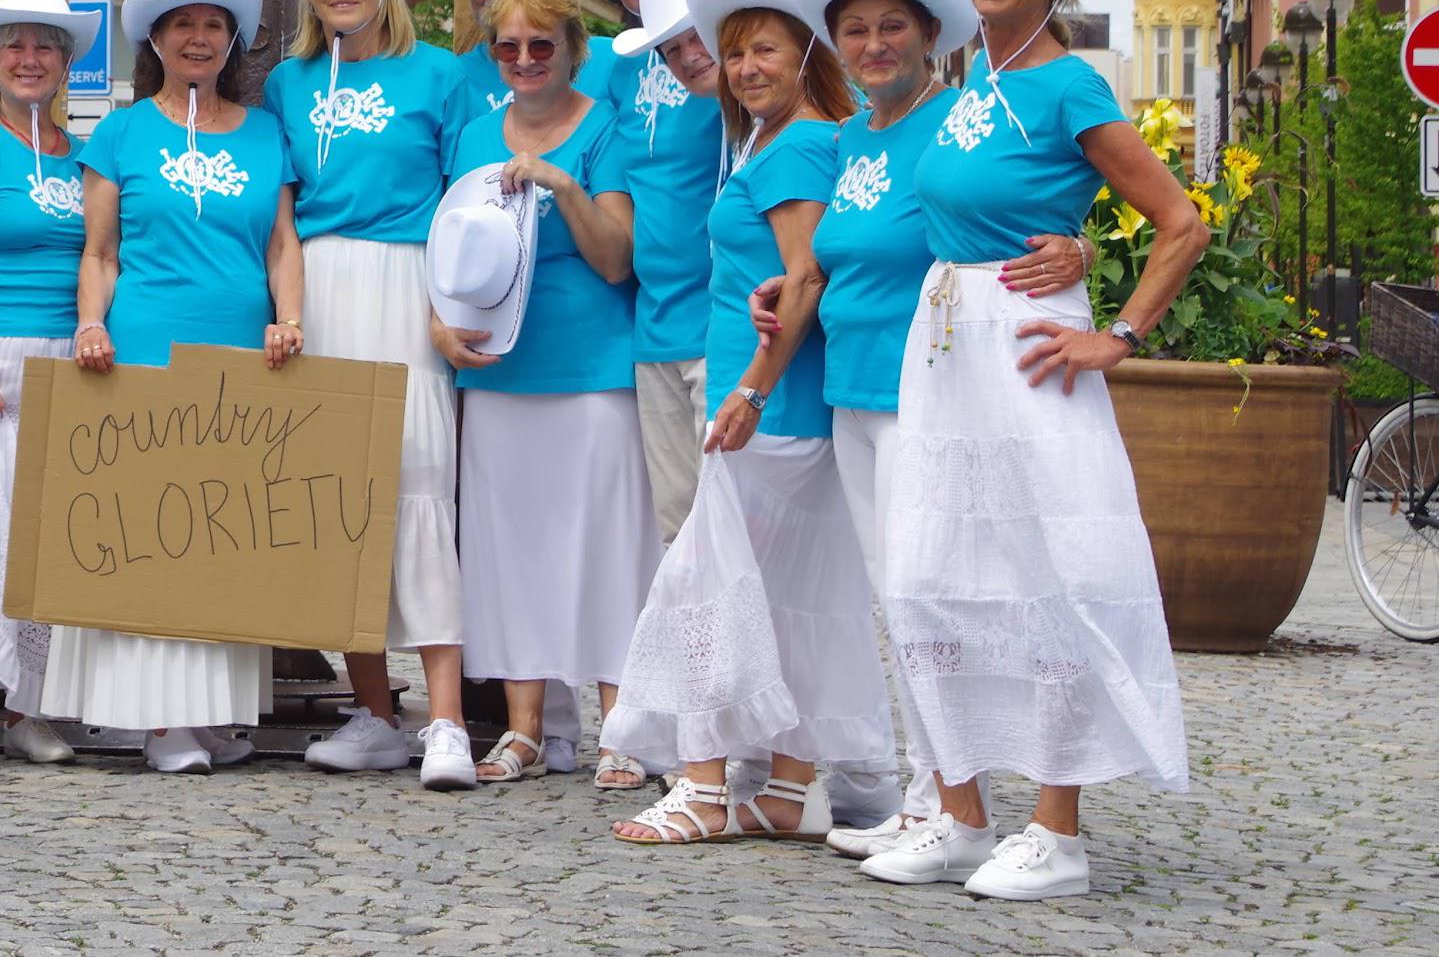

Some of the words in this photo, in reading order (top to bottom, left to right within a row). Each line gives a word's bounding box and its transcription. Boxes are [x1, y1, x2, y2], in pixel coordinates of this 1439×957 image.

[68, 68, 105, 84] SERVÉ
[70, 371, 322, 483] country
[67, 474, 374, 577] GLORIETU
